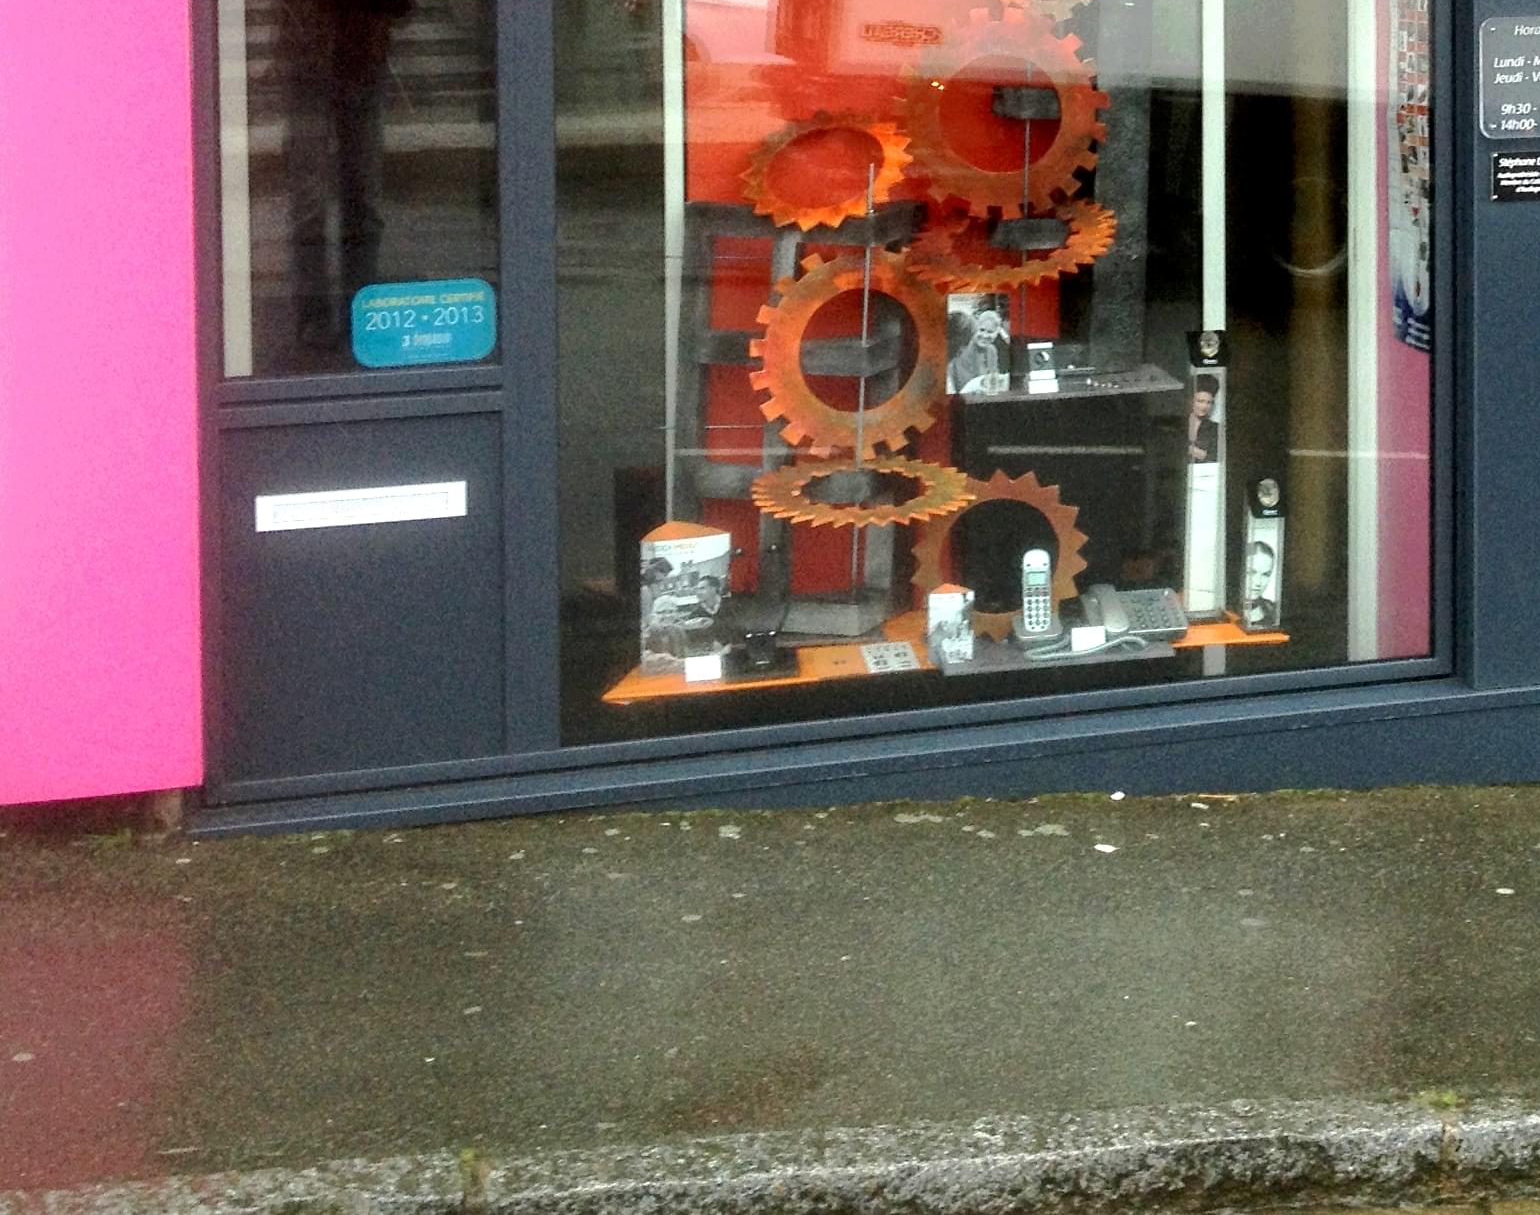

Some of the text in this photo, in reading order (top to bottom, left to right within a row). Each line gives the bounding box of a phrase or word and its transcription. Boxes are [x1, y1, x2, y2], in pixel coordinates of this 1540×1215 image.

[1493, 56, 1525, 68] Lundi
[1493, 72, 1523, 84] Jeudi
[1501, 103, 1531, 115] 9h30
[365, 305, 485, 331] 2012 2013
